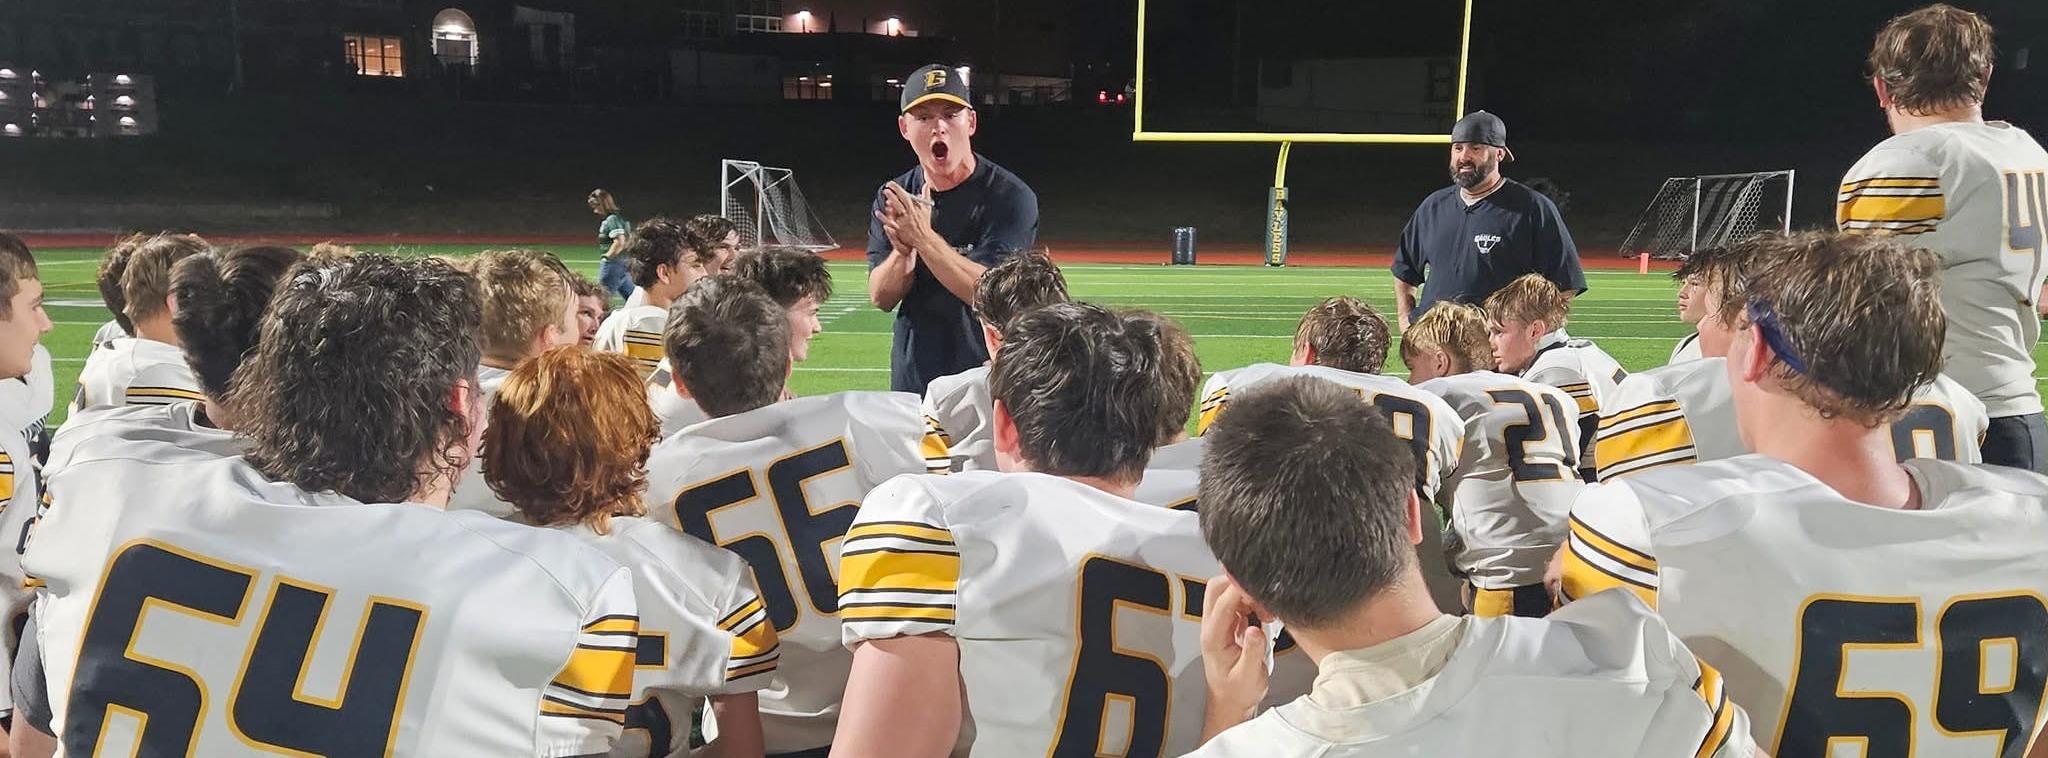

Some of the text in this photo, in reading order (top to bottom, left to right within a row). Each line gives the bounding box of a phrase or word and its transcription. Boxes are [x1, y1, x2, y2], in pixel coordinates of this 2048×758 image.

[1270, 188, 1285, 264] BAYLESS
[2002, 169, 2048, 303] 4
[1484, 388, 1586, 482] 21
[62, 537, 430, 758] 64
[1046, 552, 1208, 758] 6
[1769, 589, 2048, 758] 69
